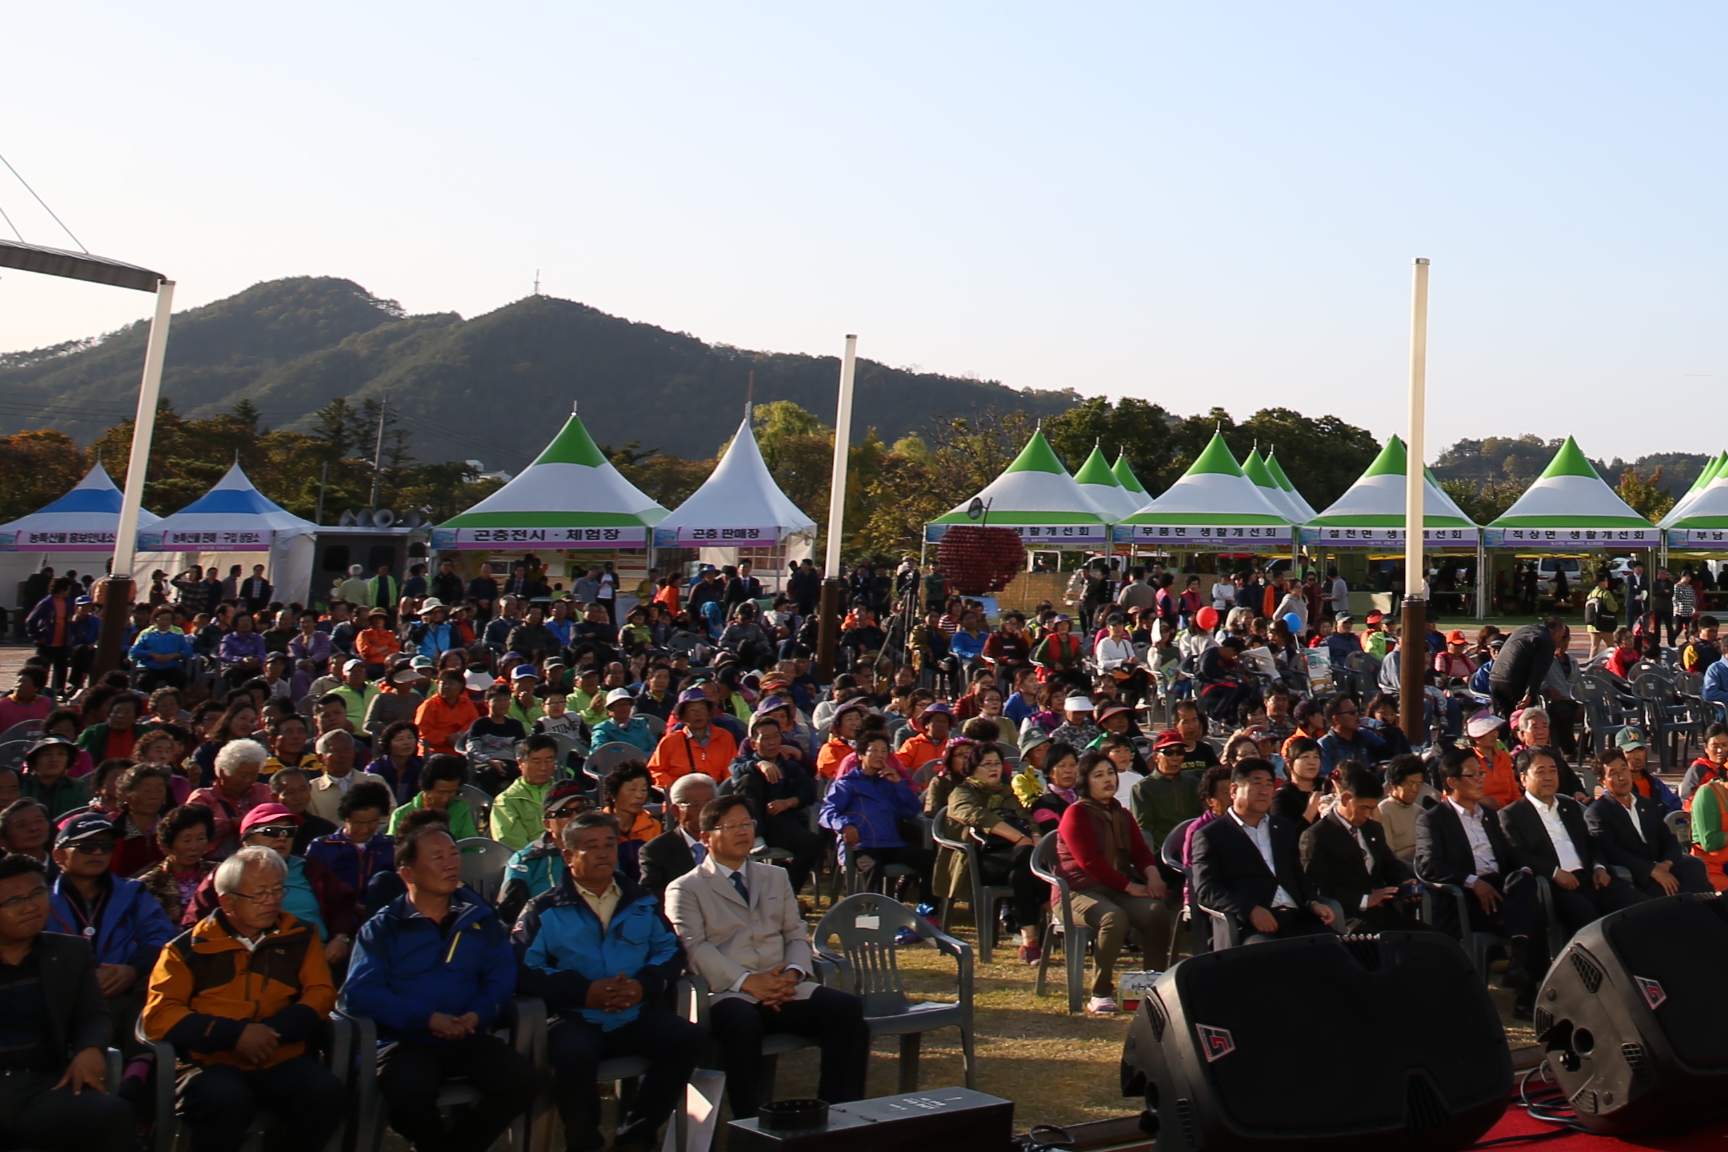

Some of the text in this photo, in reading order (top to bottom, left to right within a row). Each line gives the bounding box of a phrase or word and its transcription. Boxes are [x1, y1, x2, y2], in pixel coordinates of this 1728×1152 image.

[473, 529, 546, 542] 곤충전시
[566, 528, 621, 541] 체험장
[692, 528, 760, 540] 곤충 판매장
[1014, 527, 1090, 537] 생활개선회
[1142, 527, 1277, 538] 무풍면 생활개선회
[1329, 529, 1372, 540] 설천면
[1512, 530, 1645, 541] 적상면 생활개선회
[29, 532, 116, 544] 농특산물 홍보안내소
[172, 532, 201, 544] 농특산물
[223, 532, 238, 544] 구입
